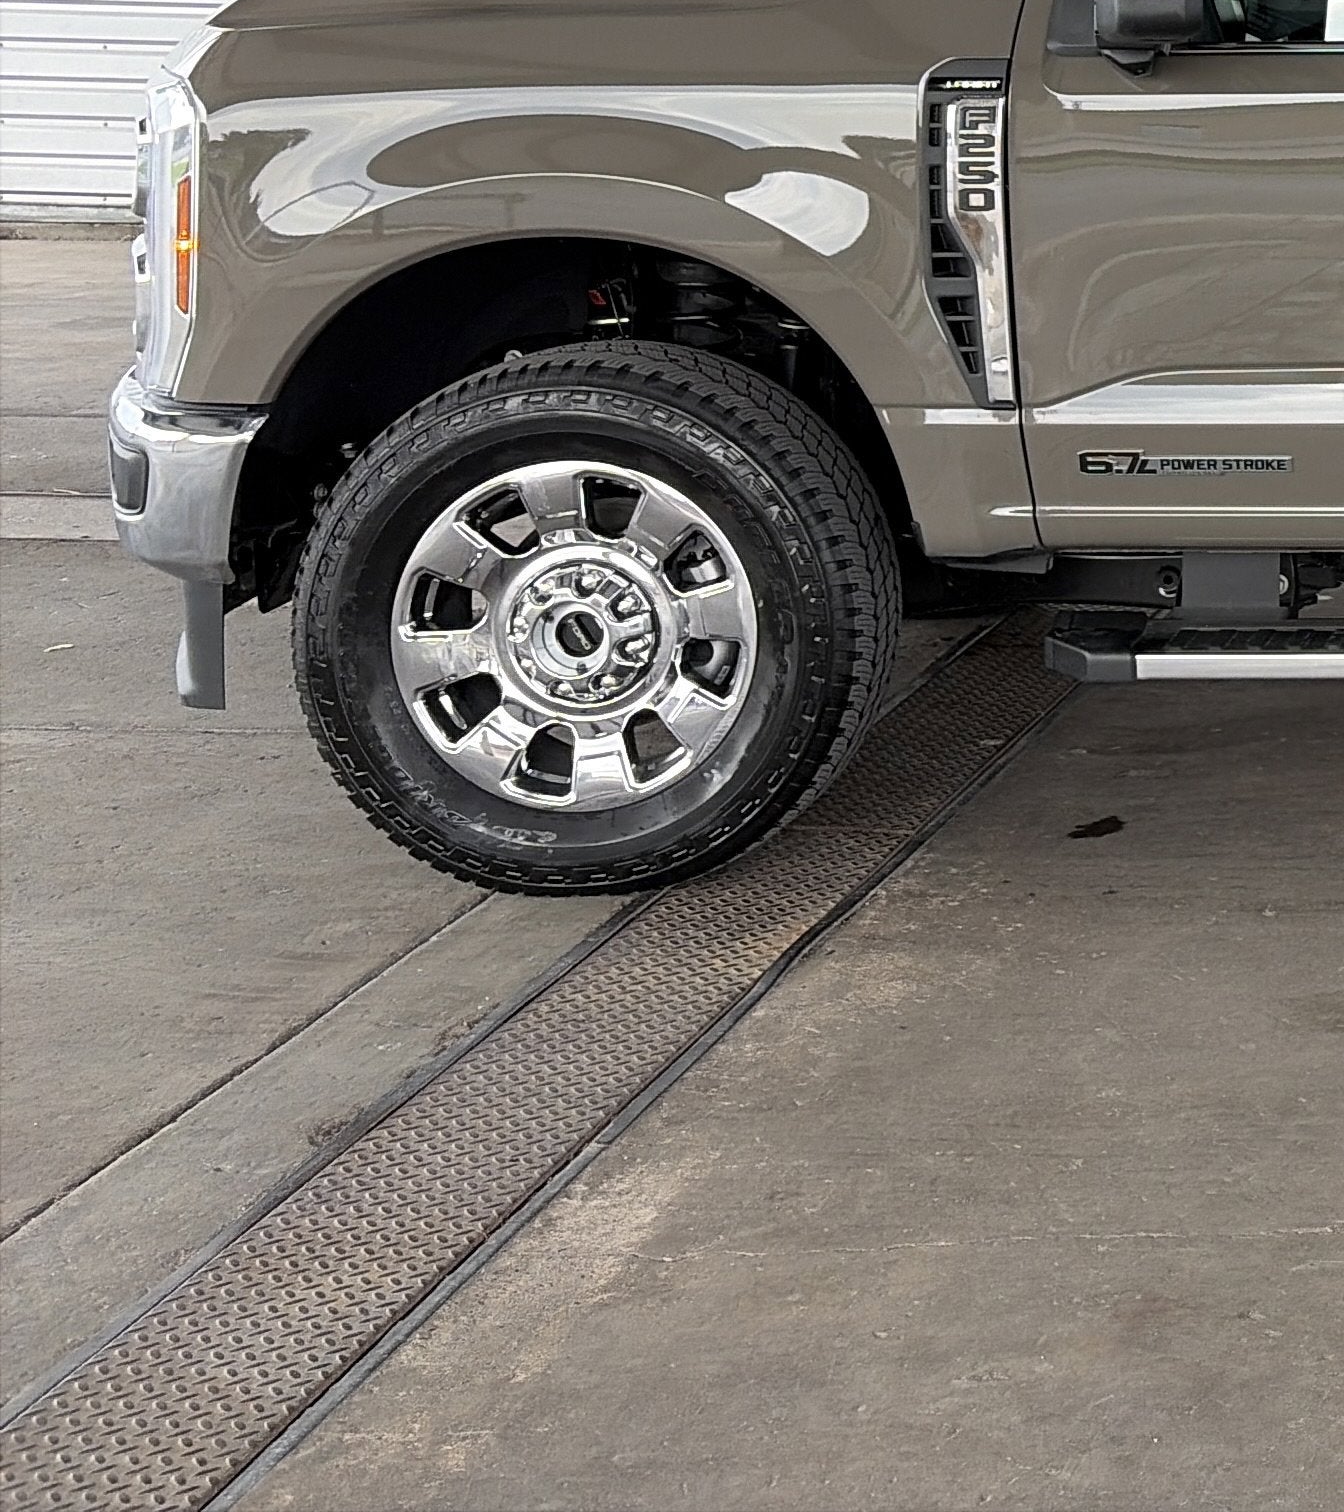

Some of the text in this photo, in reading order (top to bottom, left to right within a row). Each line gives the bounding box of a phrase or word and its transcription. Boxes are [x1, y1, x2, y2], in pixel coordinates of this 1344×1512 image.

[958, 106, 996, 211] F250
[1078, 451, 1288, 475] 6.7L POWER STROKE
